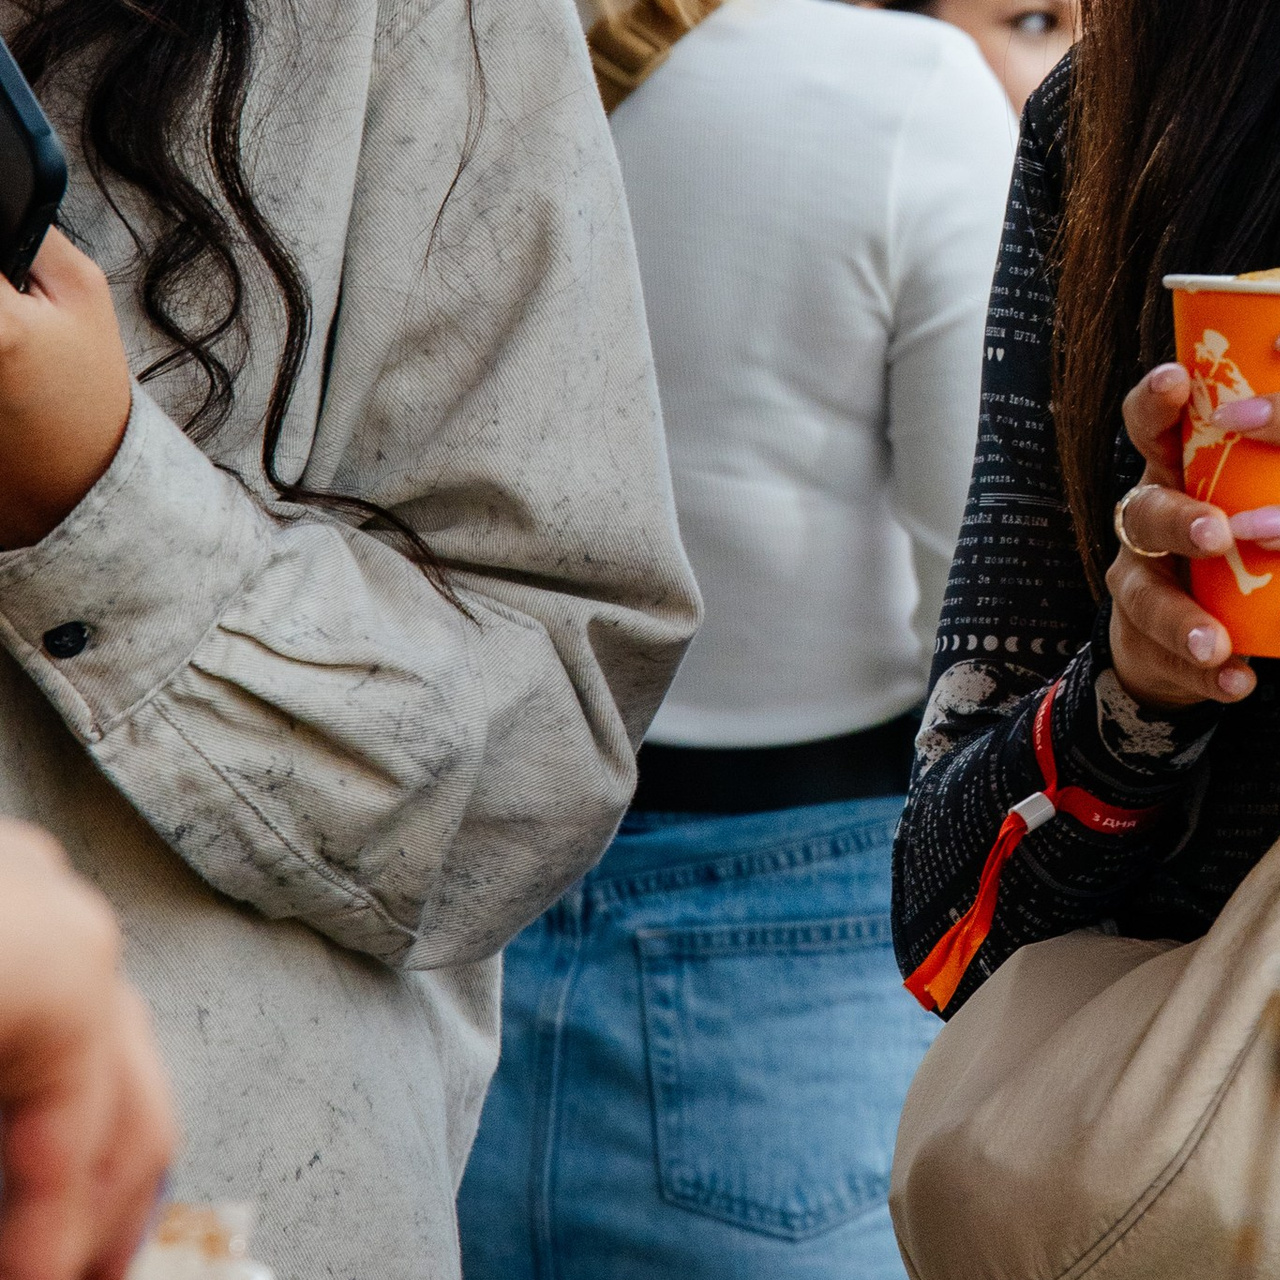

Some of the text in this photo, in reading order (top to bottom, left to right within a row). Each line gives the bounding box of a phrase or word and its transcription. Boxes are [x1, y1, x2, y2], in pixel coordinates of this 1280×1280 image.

[1013, 329, 1041, 345] ПУТИ.
[1001, 513, 1048, 527] КАЖДЫМ
[984, 556, 1027, 567] помни,
[977, 596, 1013, 607] утро.
